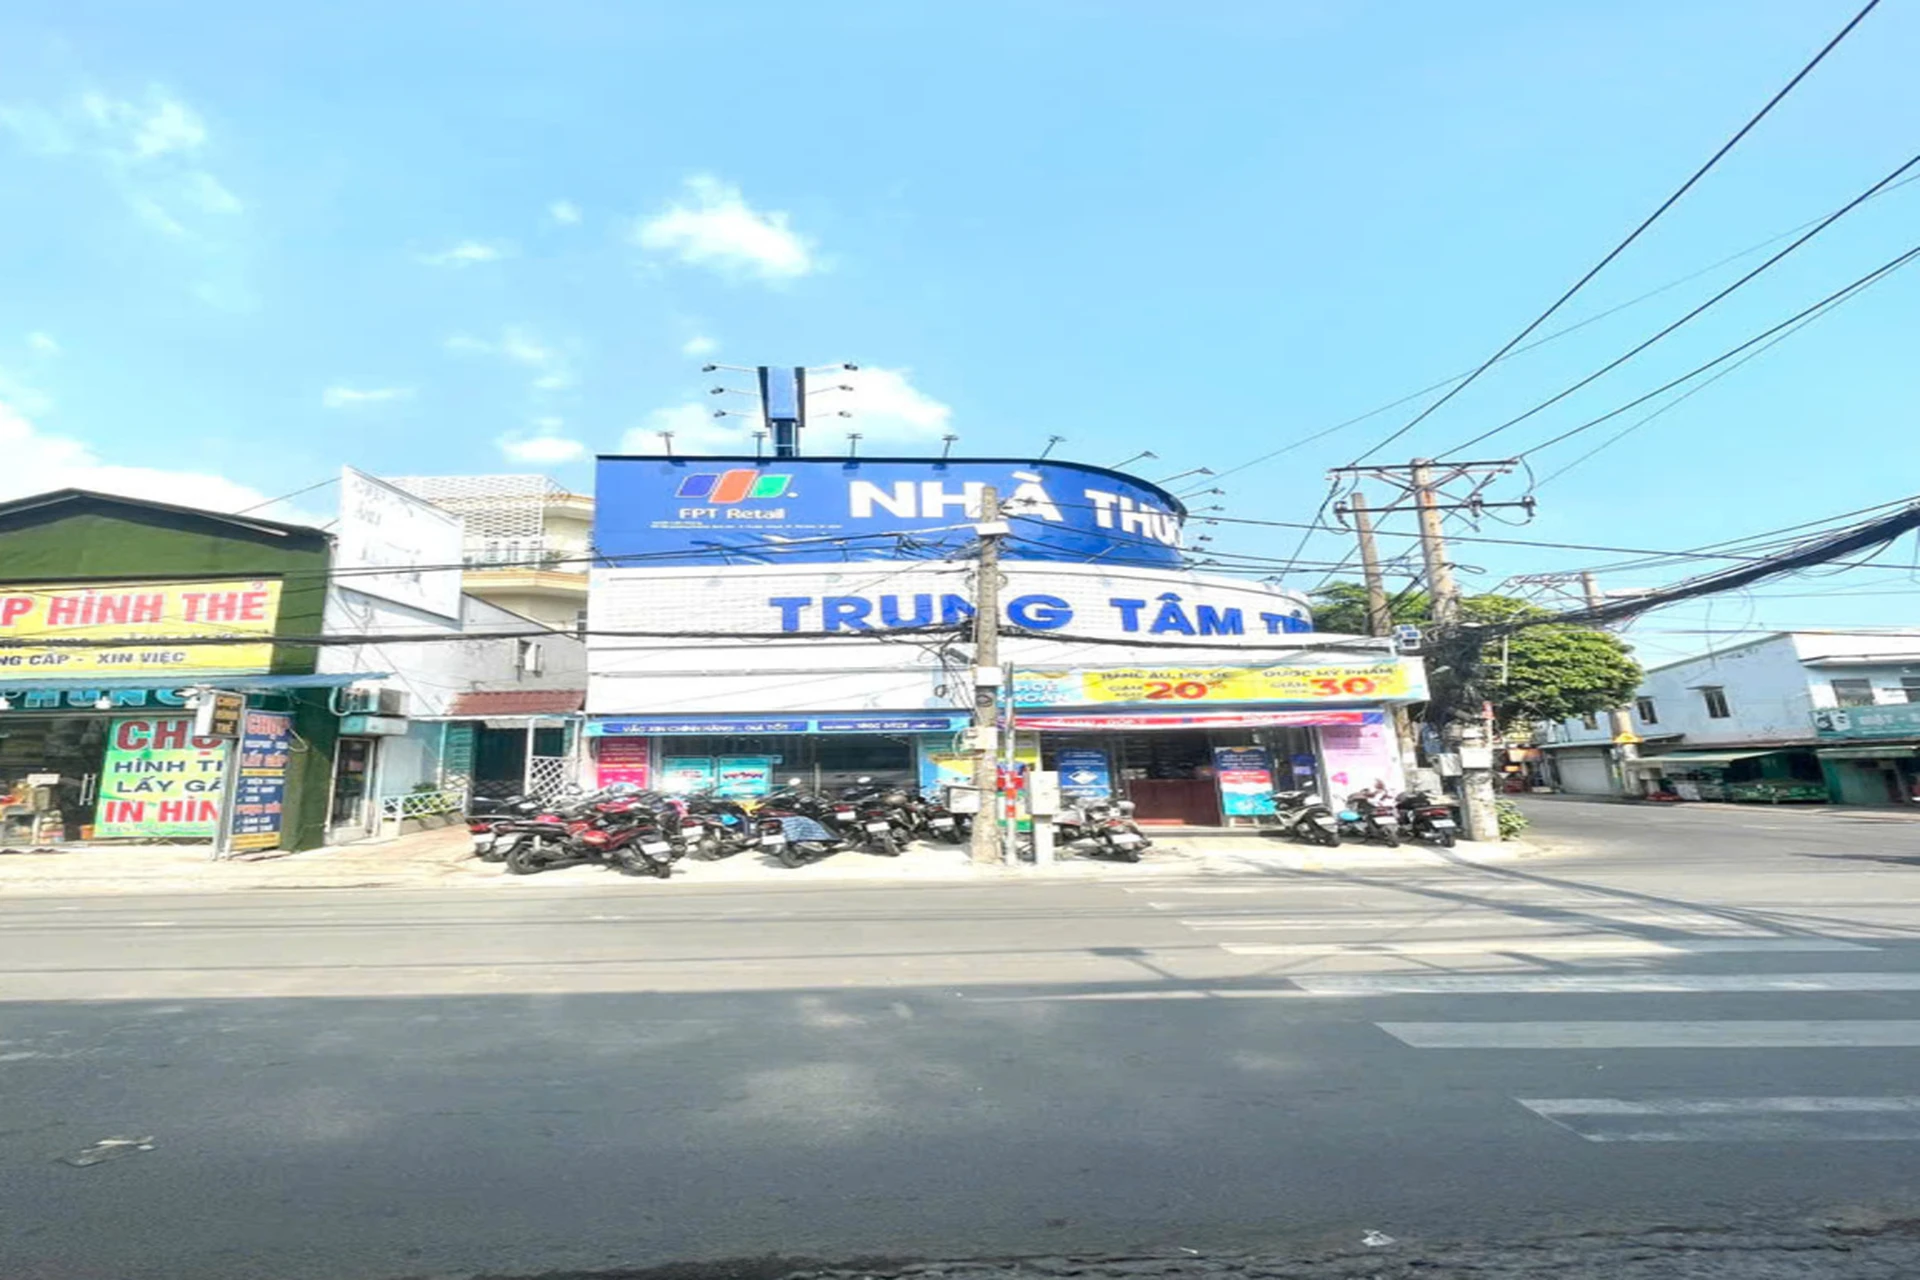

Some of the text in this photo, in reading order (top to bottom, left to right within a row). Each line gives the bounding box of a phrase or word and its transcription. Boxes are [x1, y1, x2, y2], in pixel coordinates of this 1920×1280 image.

[849, 470, 1063, 521] NHÀ
[679, 508, 785, 519] FPT Retail
[47, 590, 163, 625] HÌNH
[182, 581, 268, 621] THẺ
[769, 594, 1073, 632] TRUNG
[1109, 592, 1244, 636] TÂM
[97, 653, 134, 664] XIN
[140, 651, 187, 664] VIỆC
[114, 758, 185, 773] HÌNH
[117, 775, 174, 793] LẤY
[105, 800, 145, 823] IN
[158, 795, 219, 823] HÌN
